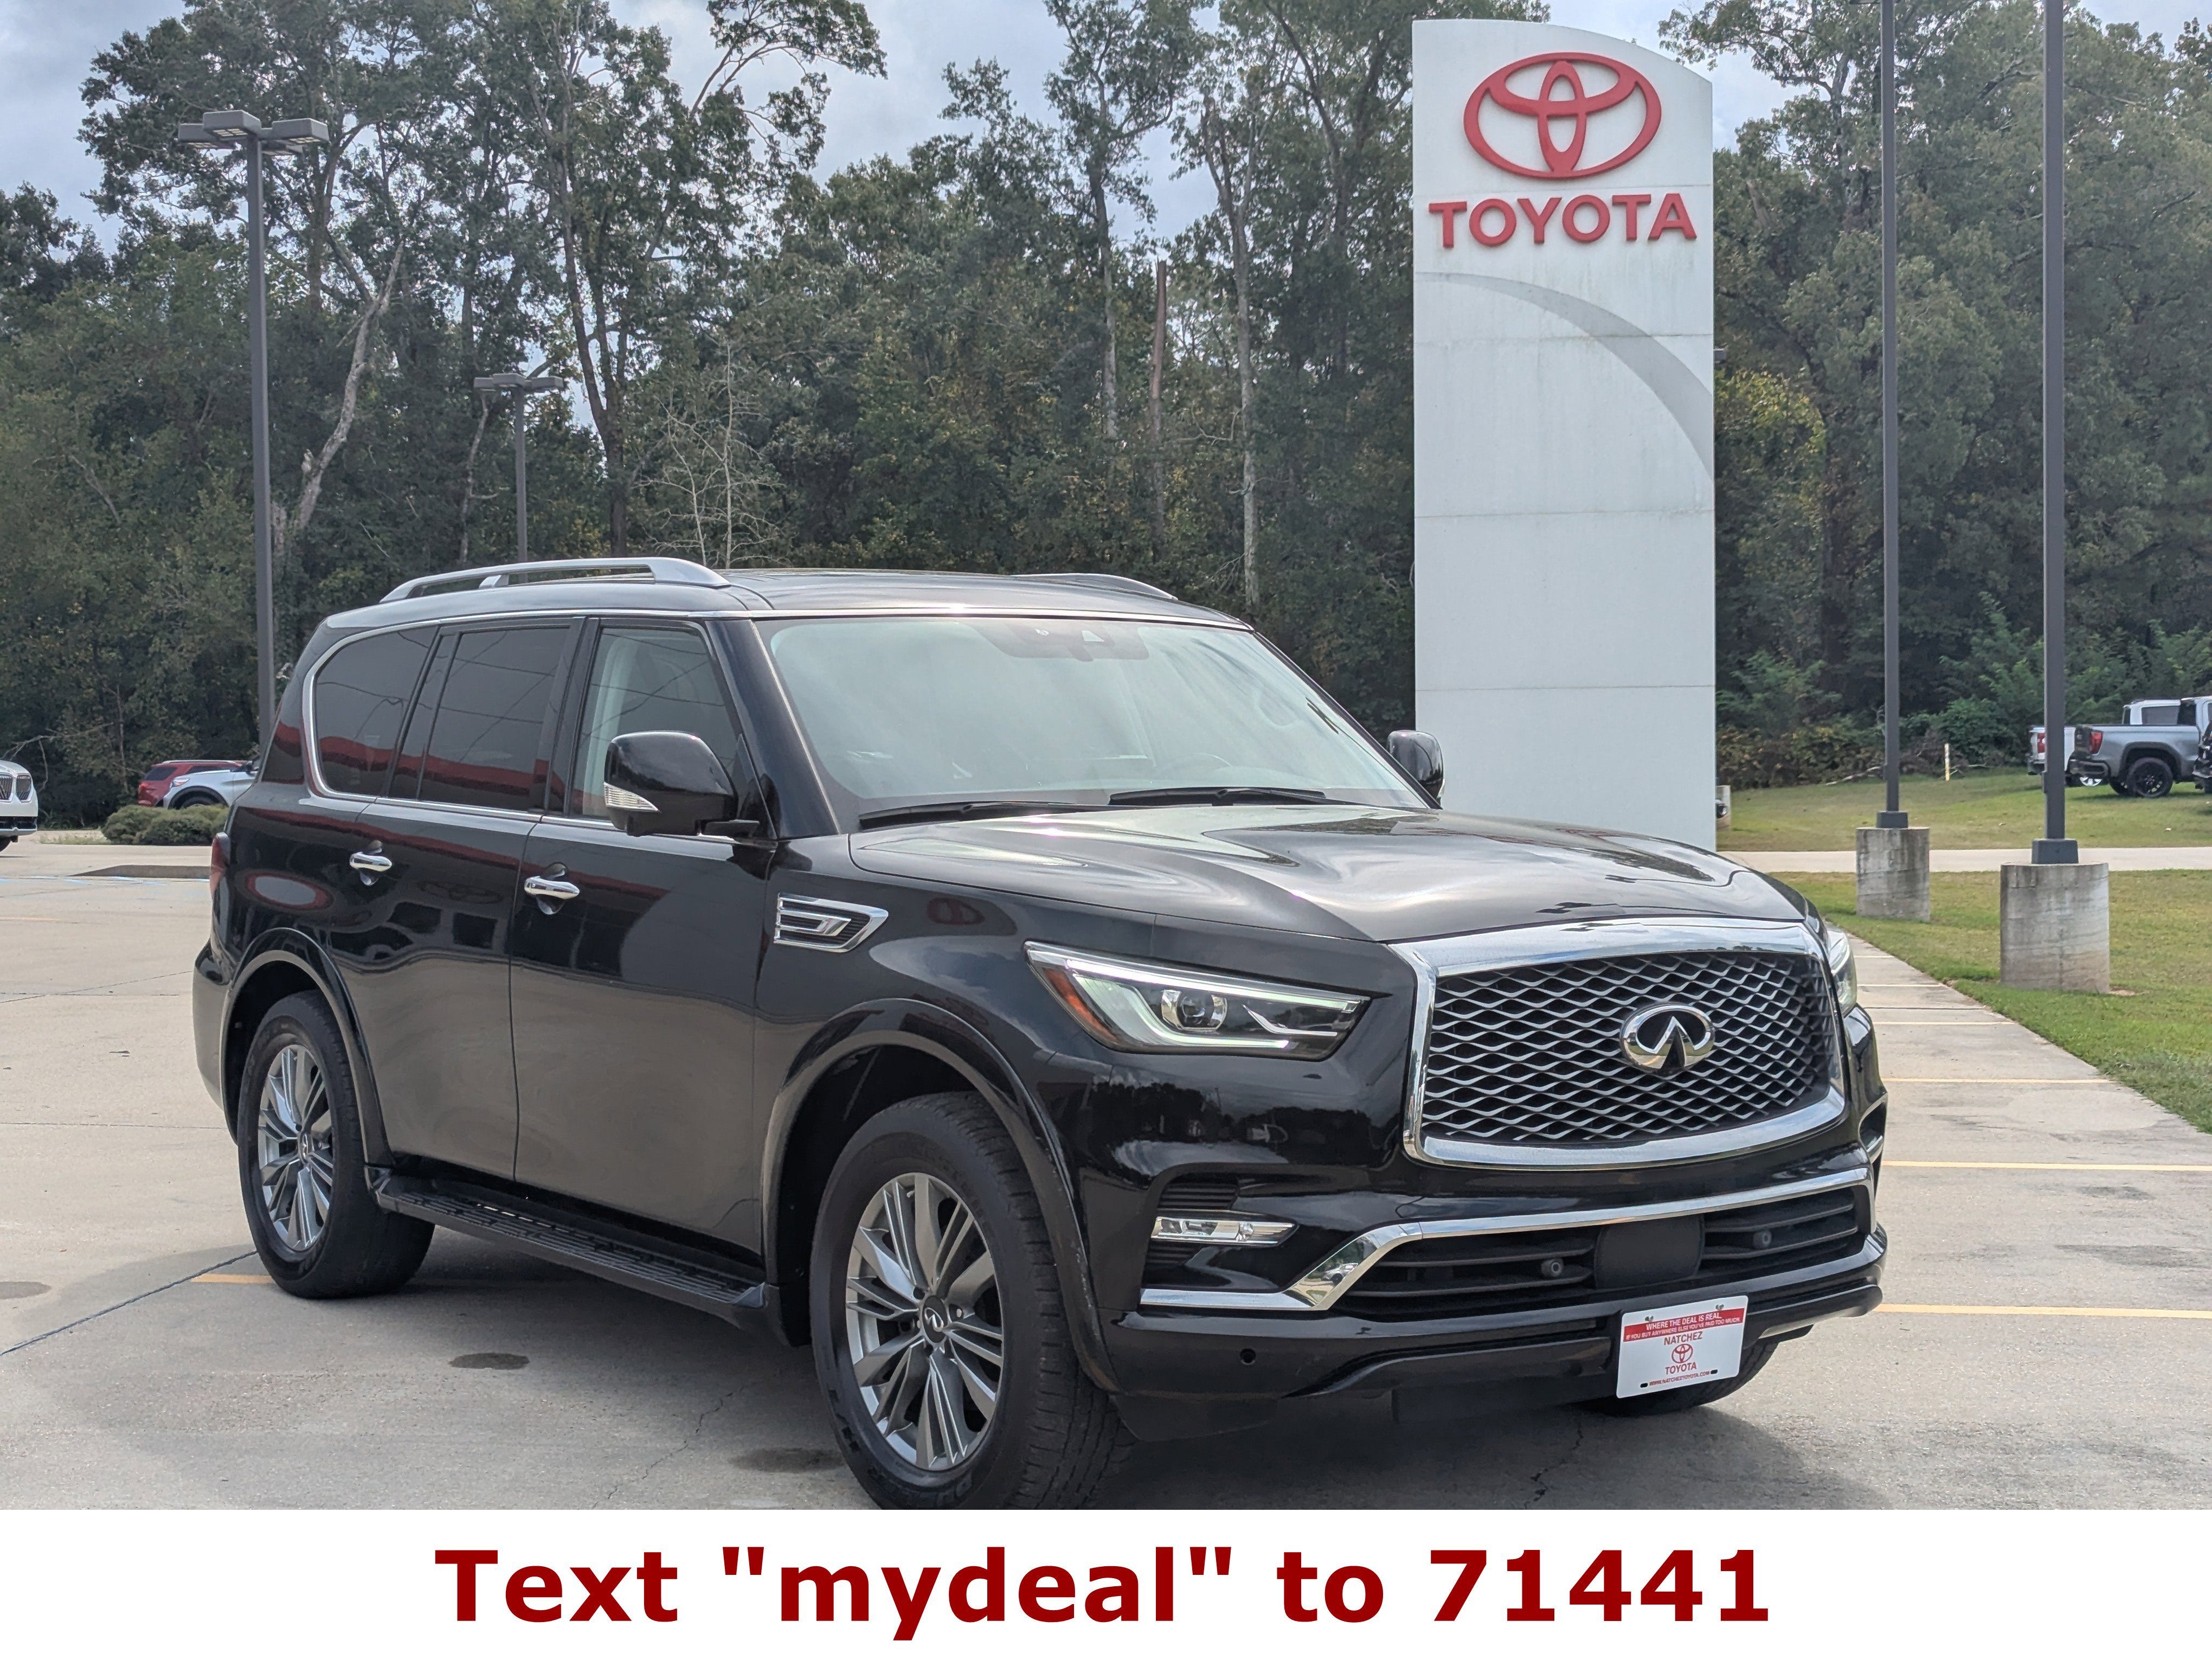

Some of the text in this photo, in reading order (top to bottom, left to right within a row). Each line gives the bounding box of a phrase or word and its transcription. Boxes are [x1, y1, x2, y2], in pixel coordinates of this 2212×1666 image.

[1429, 193, 1697, 248] TOYOTA
[1646, 1321, 1669, 1331] WHERE
[1670, 1318, 1681, 1327] THE
[1682, 1316, 1697, 1325] DEAL
[1663, 1331, 1703, 1345] NATCHEZ
[1664, 1361, 1697, 1375] TOYOTA
